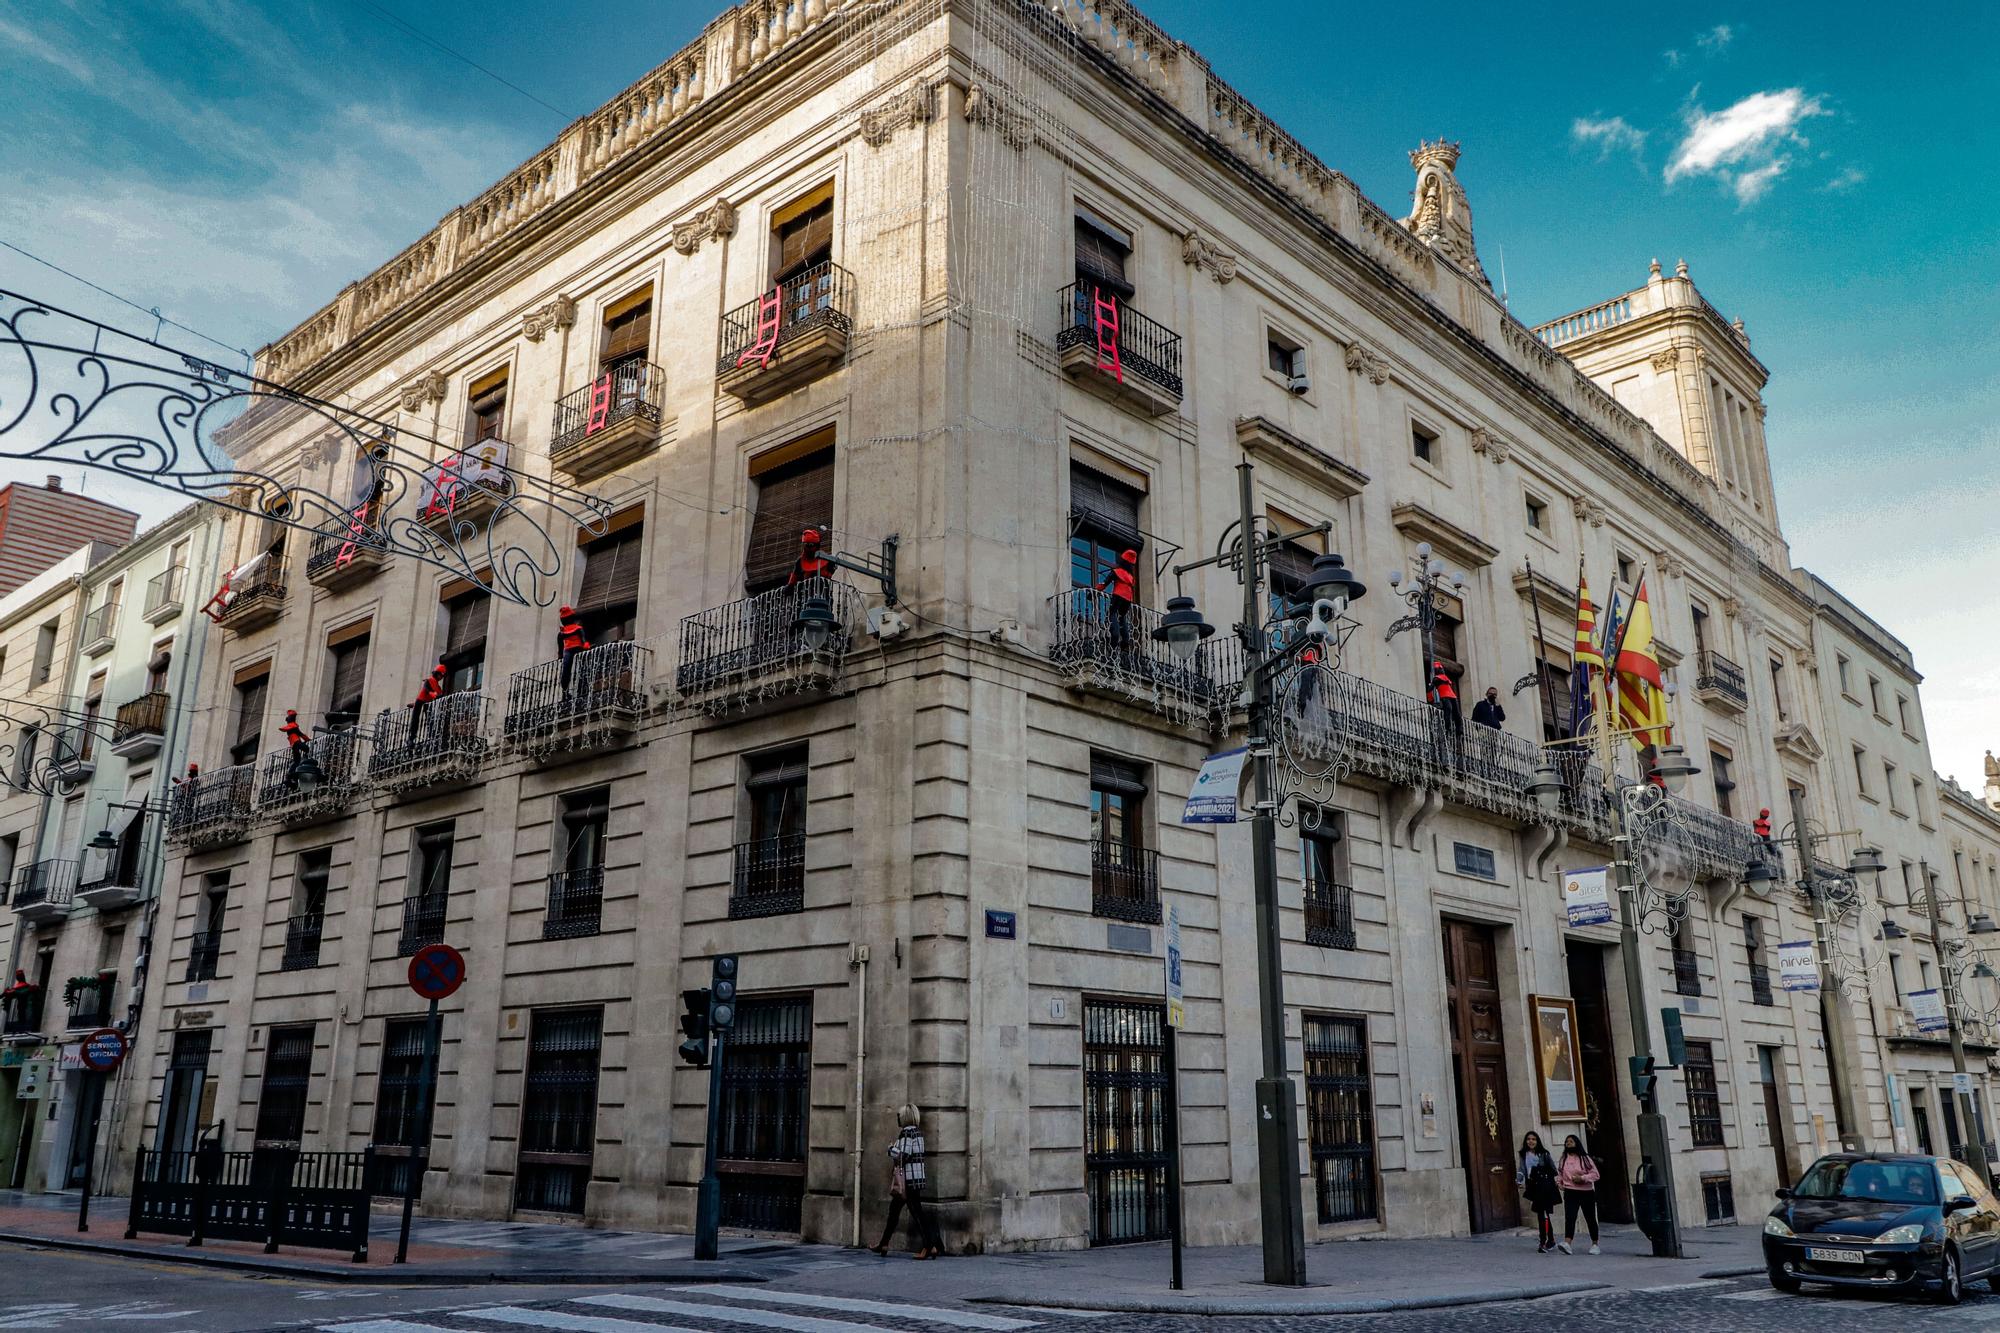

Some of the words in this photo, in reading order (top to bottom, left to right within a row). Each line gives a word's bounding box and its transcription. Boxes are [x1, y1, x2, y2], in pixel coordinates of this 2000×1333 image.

[1780, 954, 1814, 968] nirvel
[87, 1041, 122, 1050] SERVICIO
[89, 1050, 119, 1058] OFICIAL
[1813, 1250, 1838, 1260] 5839
